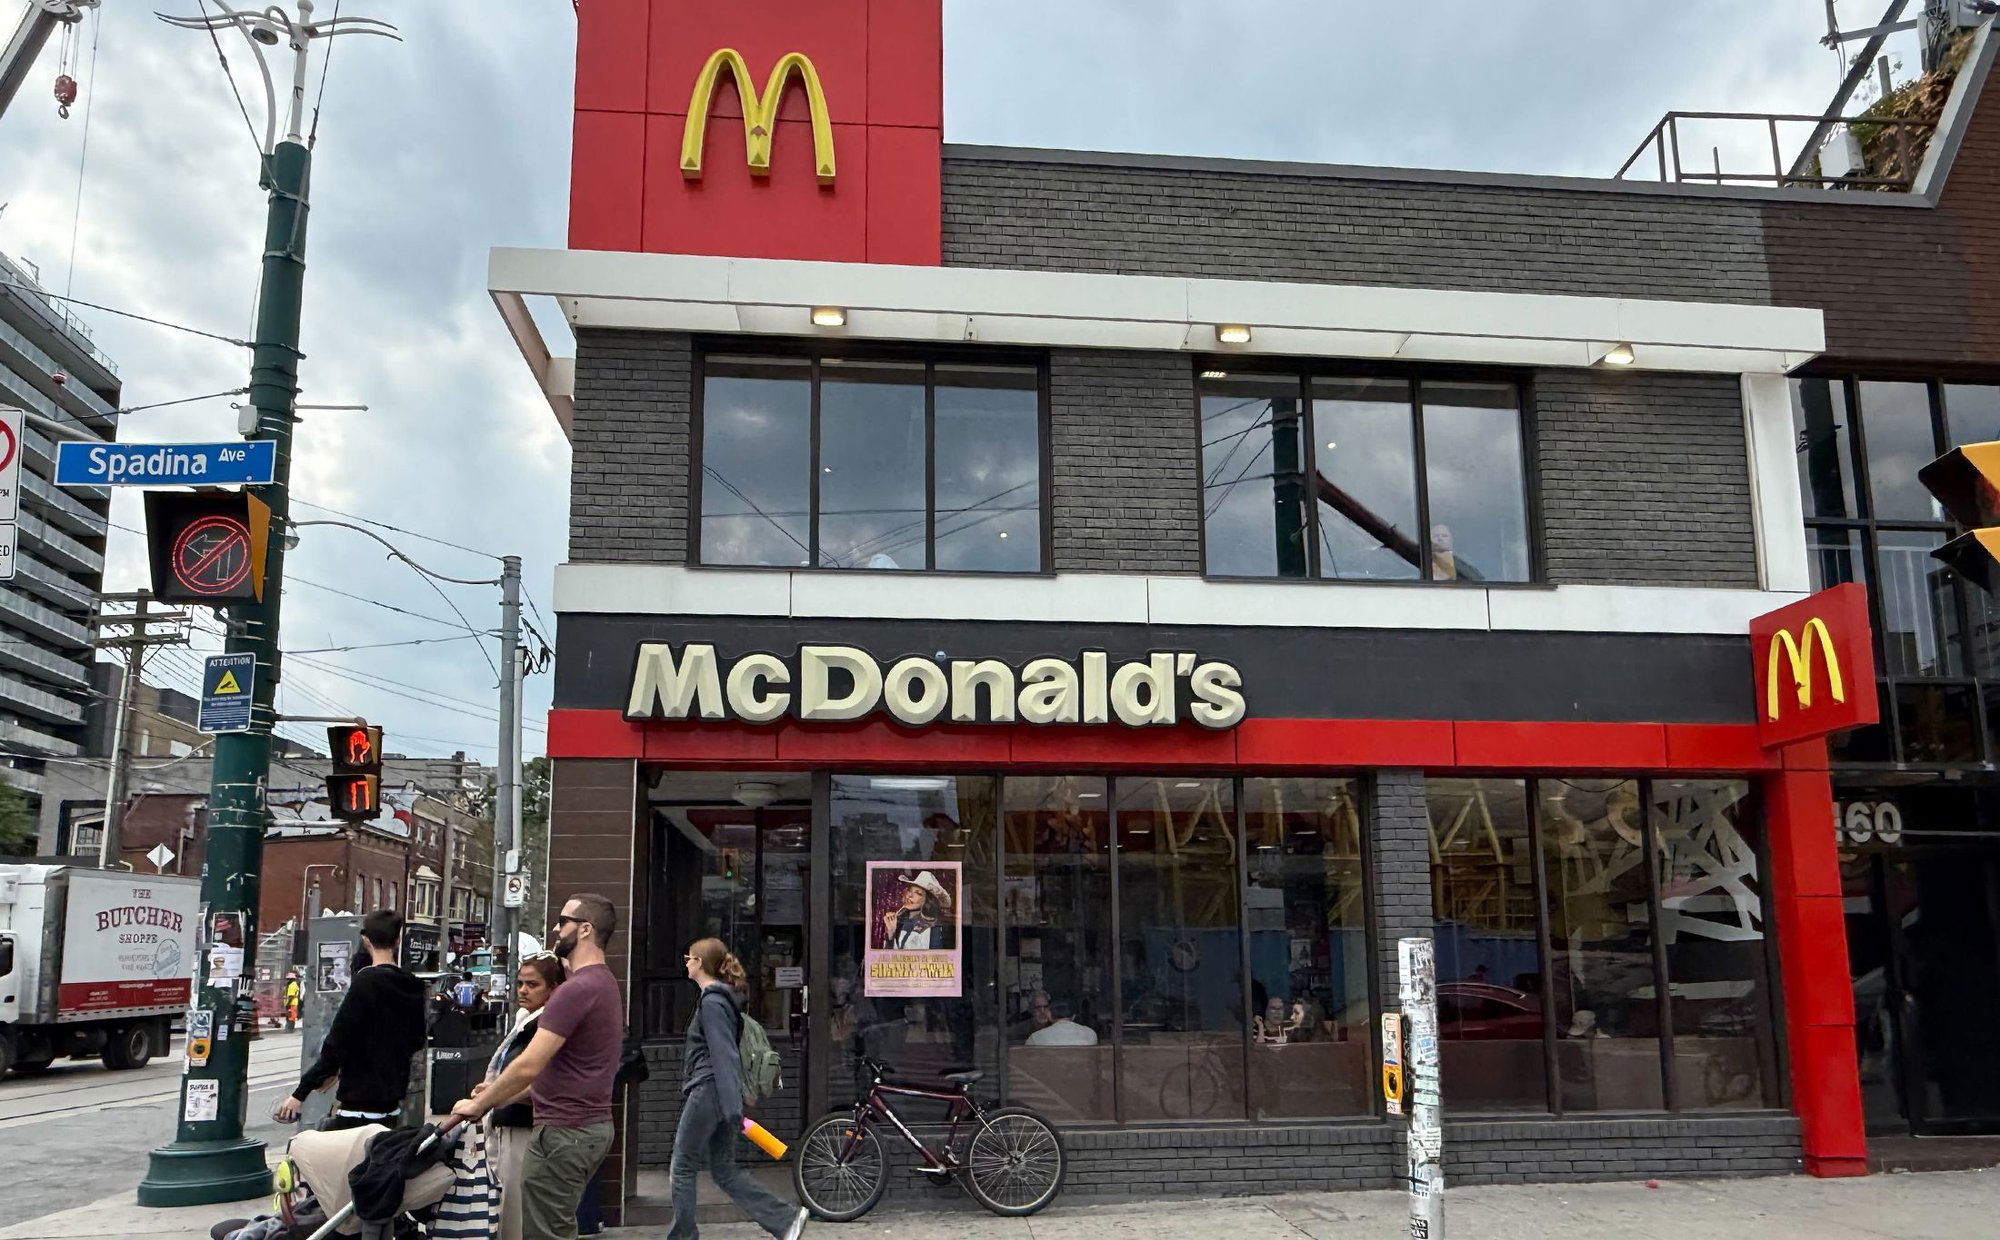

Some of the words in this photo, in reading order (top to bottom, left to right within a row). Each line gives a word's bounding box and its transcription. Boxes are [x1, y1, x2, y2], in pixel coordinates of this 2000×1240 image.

[88, 447, 207, 481] Spadina
[218, 447, 246, 462] Ave
[210, 656, 251, 668] ATTENTION
[627, 643, 1247, 729] McDonald's
[132, 888, 151, 899] THE
[96, 906, 183, 933] BUTCHER
[118, 933, 158, 944] SHOPPE
